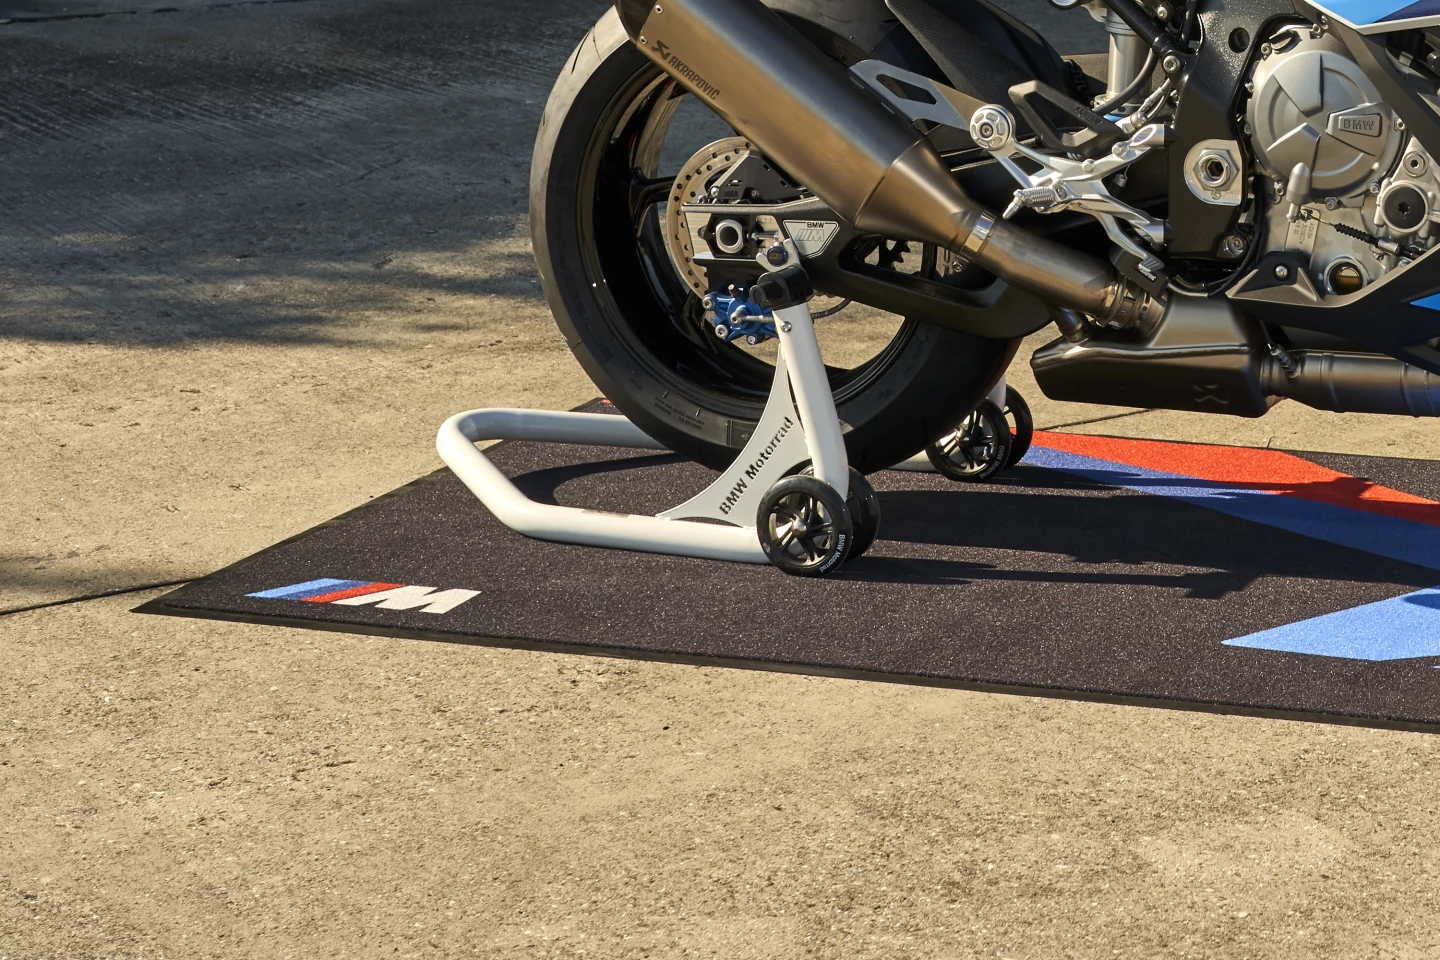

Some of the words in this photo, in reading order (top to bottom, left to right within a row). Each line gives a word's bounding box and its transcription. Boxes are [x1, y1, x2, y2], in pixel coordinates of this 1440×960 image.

[1343, 118, 1376, 131] BMW
[719, 477, 748, 516] BMW
[746, 416, 795, 481] Motorrad
[837, 534, 846, 552] BMW
